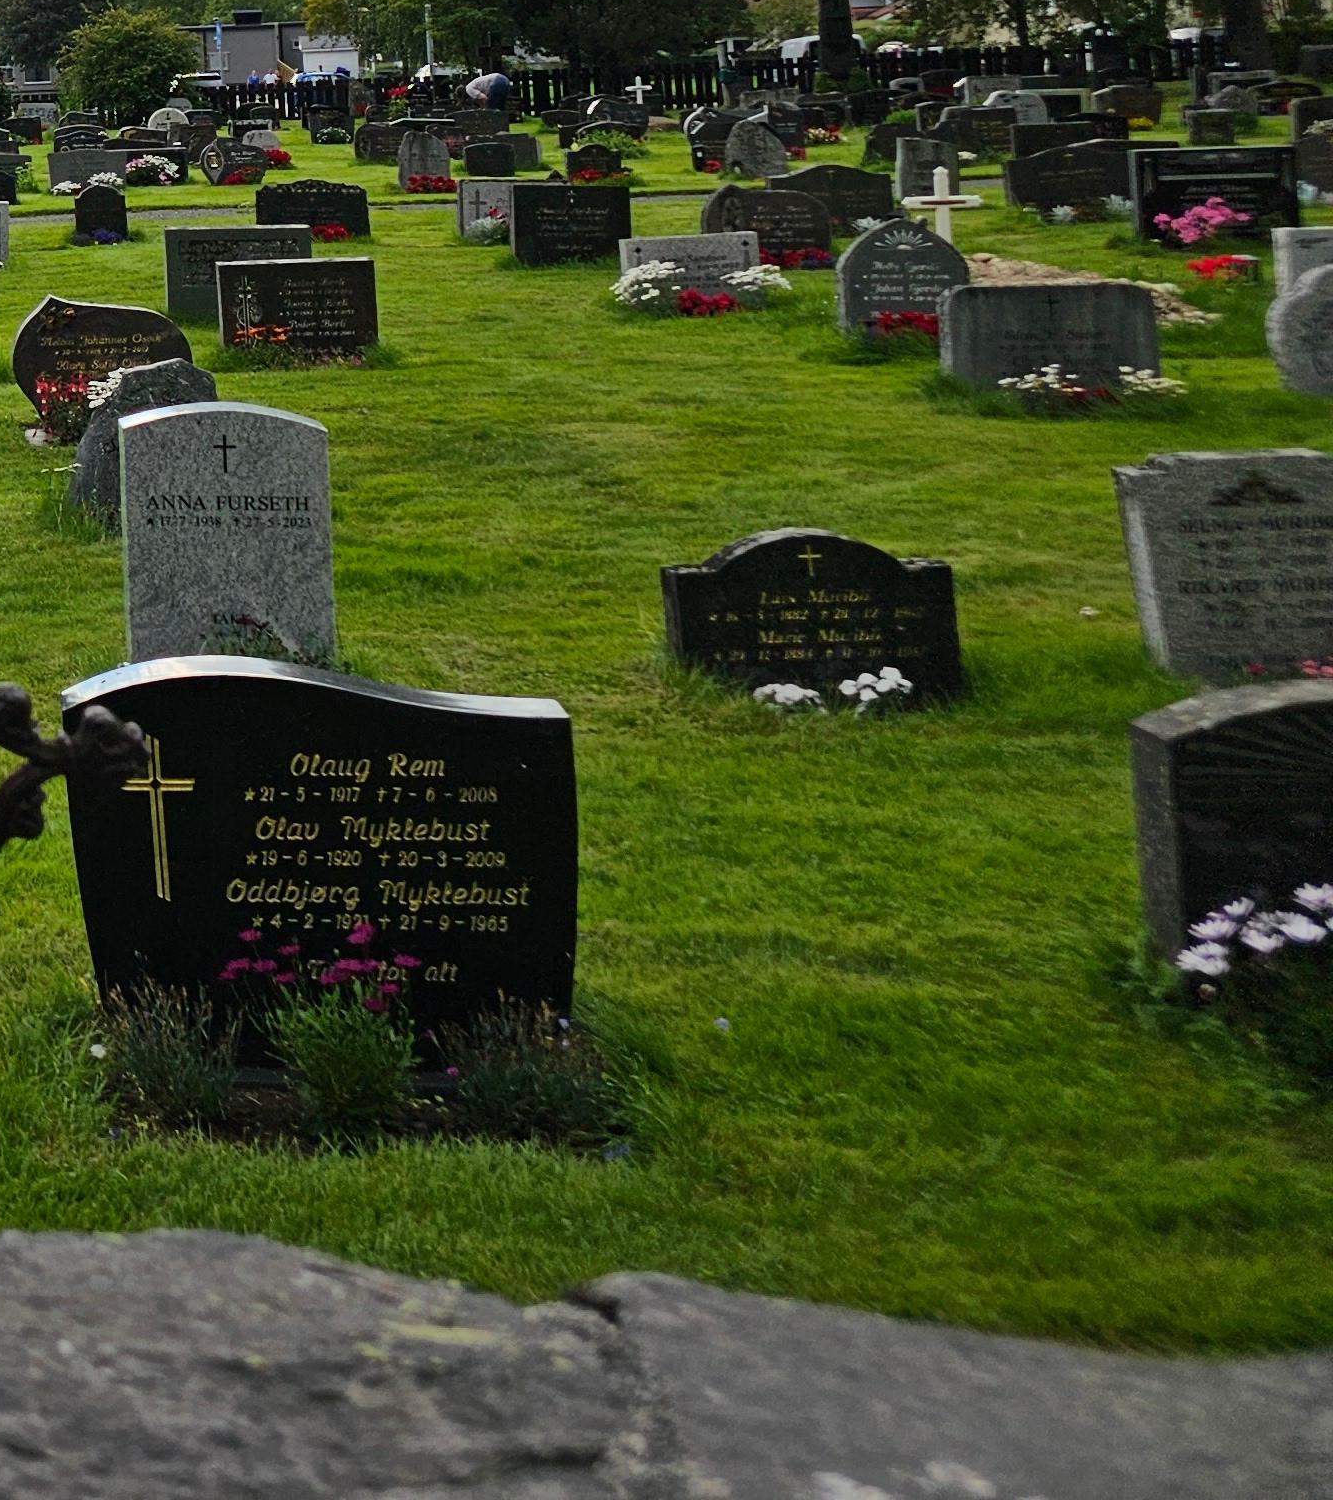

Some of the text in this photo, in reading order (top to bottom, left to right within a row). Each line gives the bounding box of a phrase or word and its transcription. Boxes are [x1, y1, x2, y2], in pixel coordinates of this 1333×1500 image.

[145, 494, 311, 512] ANNA FURSETH
[290, 752, 446, 783] Olaug Rem
[255, 815, 491, 848] Olav Myklebust
[226, 877, 531, 912] Oddbjørg Myklebust
[424, 961, 460, 982] alt
